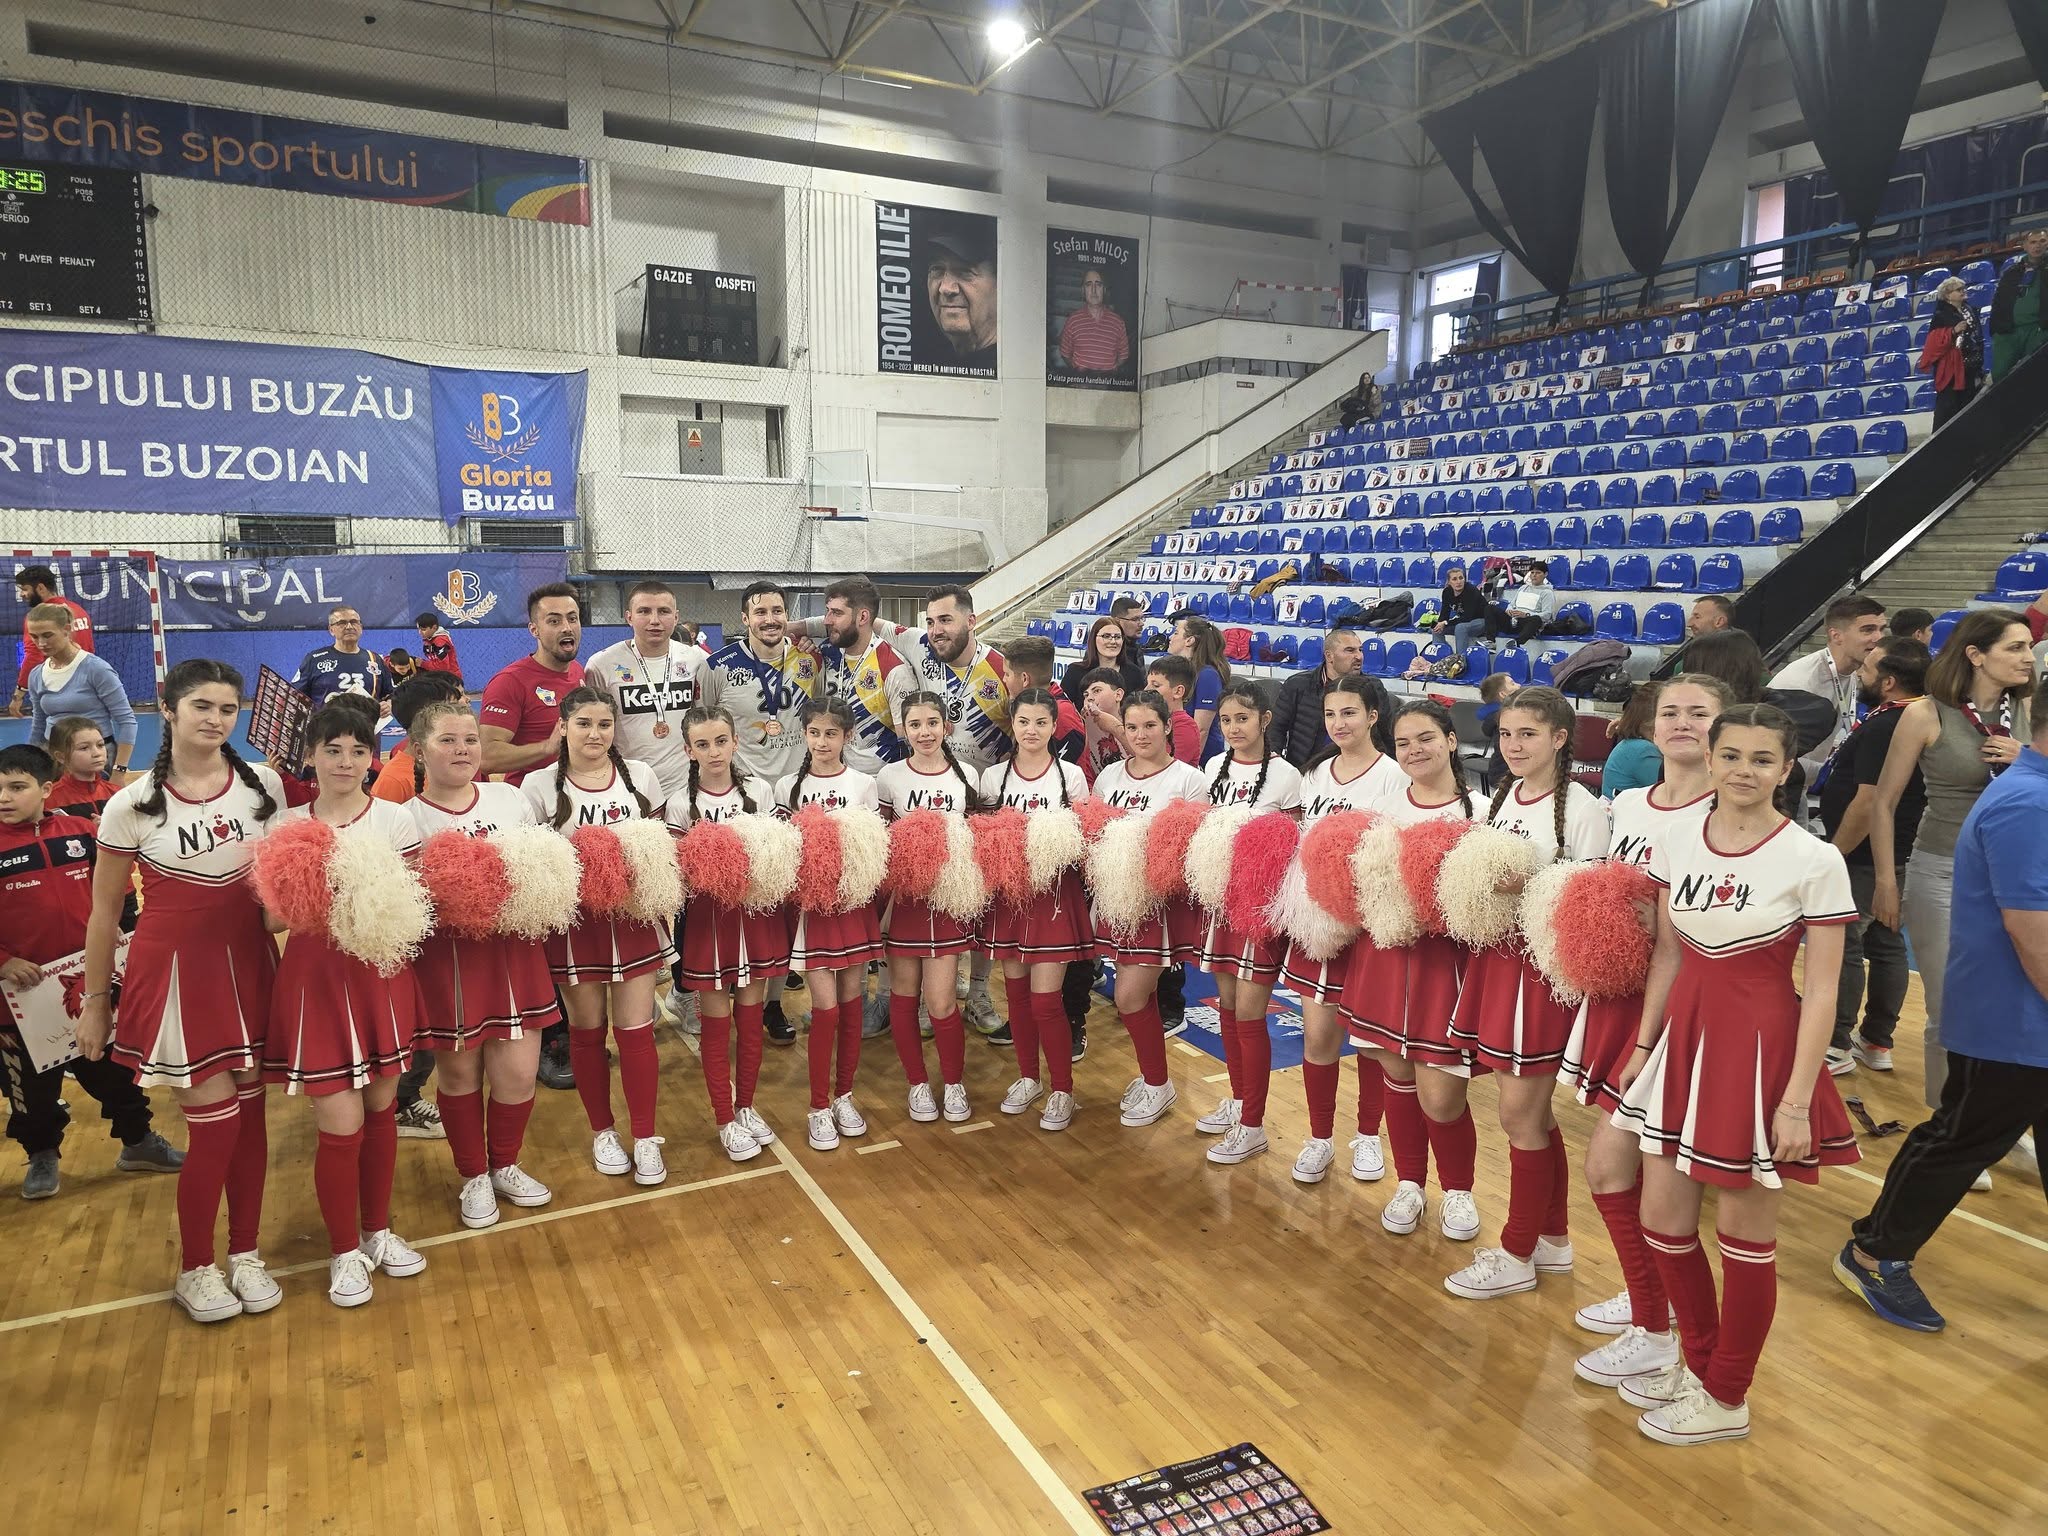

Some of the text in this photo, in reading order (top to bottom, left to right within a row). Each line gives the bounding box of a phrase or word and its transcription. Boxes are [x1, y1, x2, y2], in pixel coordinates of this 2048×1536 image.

[182, 130, 418, 189] sportului
[70, 176, 93, 185] FOULS
[132, 175, 137, 184] 4
[136, 224, 141, 233] 8
[136, 237, 142, 245] 9
[1053, 236, 1088, 255] Stefan
[134, 249, 143, 258] 10
[19, 253, 52, 264] PLAYER
[59, 256, 96, 267] PENALTY
[135, 261, 143, 269] 11
[136, 273, 145, 282] 12
[654, 268, 693, 285] GAZDE
[715, 276, 756, 292] OASPETI
[878, 204, 912, 362] ROMEO ILIE
[136, 285, 146, 294] 13
[137, 297, 147, 306] 14
[29, 302, 52, 312] SET 3
[79, 305, 93, 314] SET
[138, 309, 148, 318] 15
[913, 363, 932, 373] MEREU
[6, 363, 414, 421] CIPIULUI BUZĂU
[142, 442, 370, 484] BUZOIAN
[460, 463, 553, 487] Gloria
[462, 488, 555, 512] Buzău
[42, 958, 80, 979] ANDBAL
